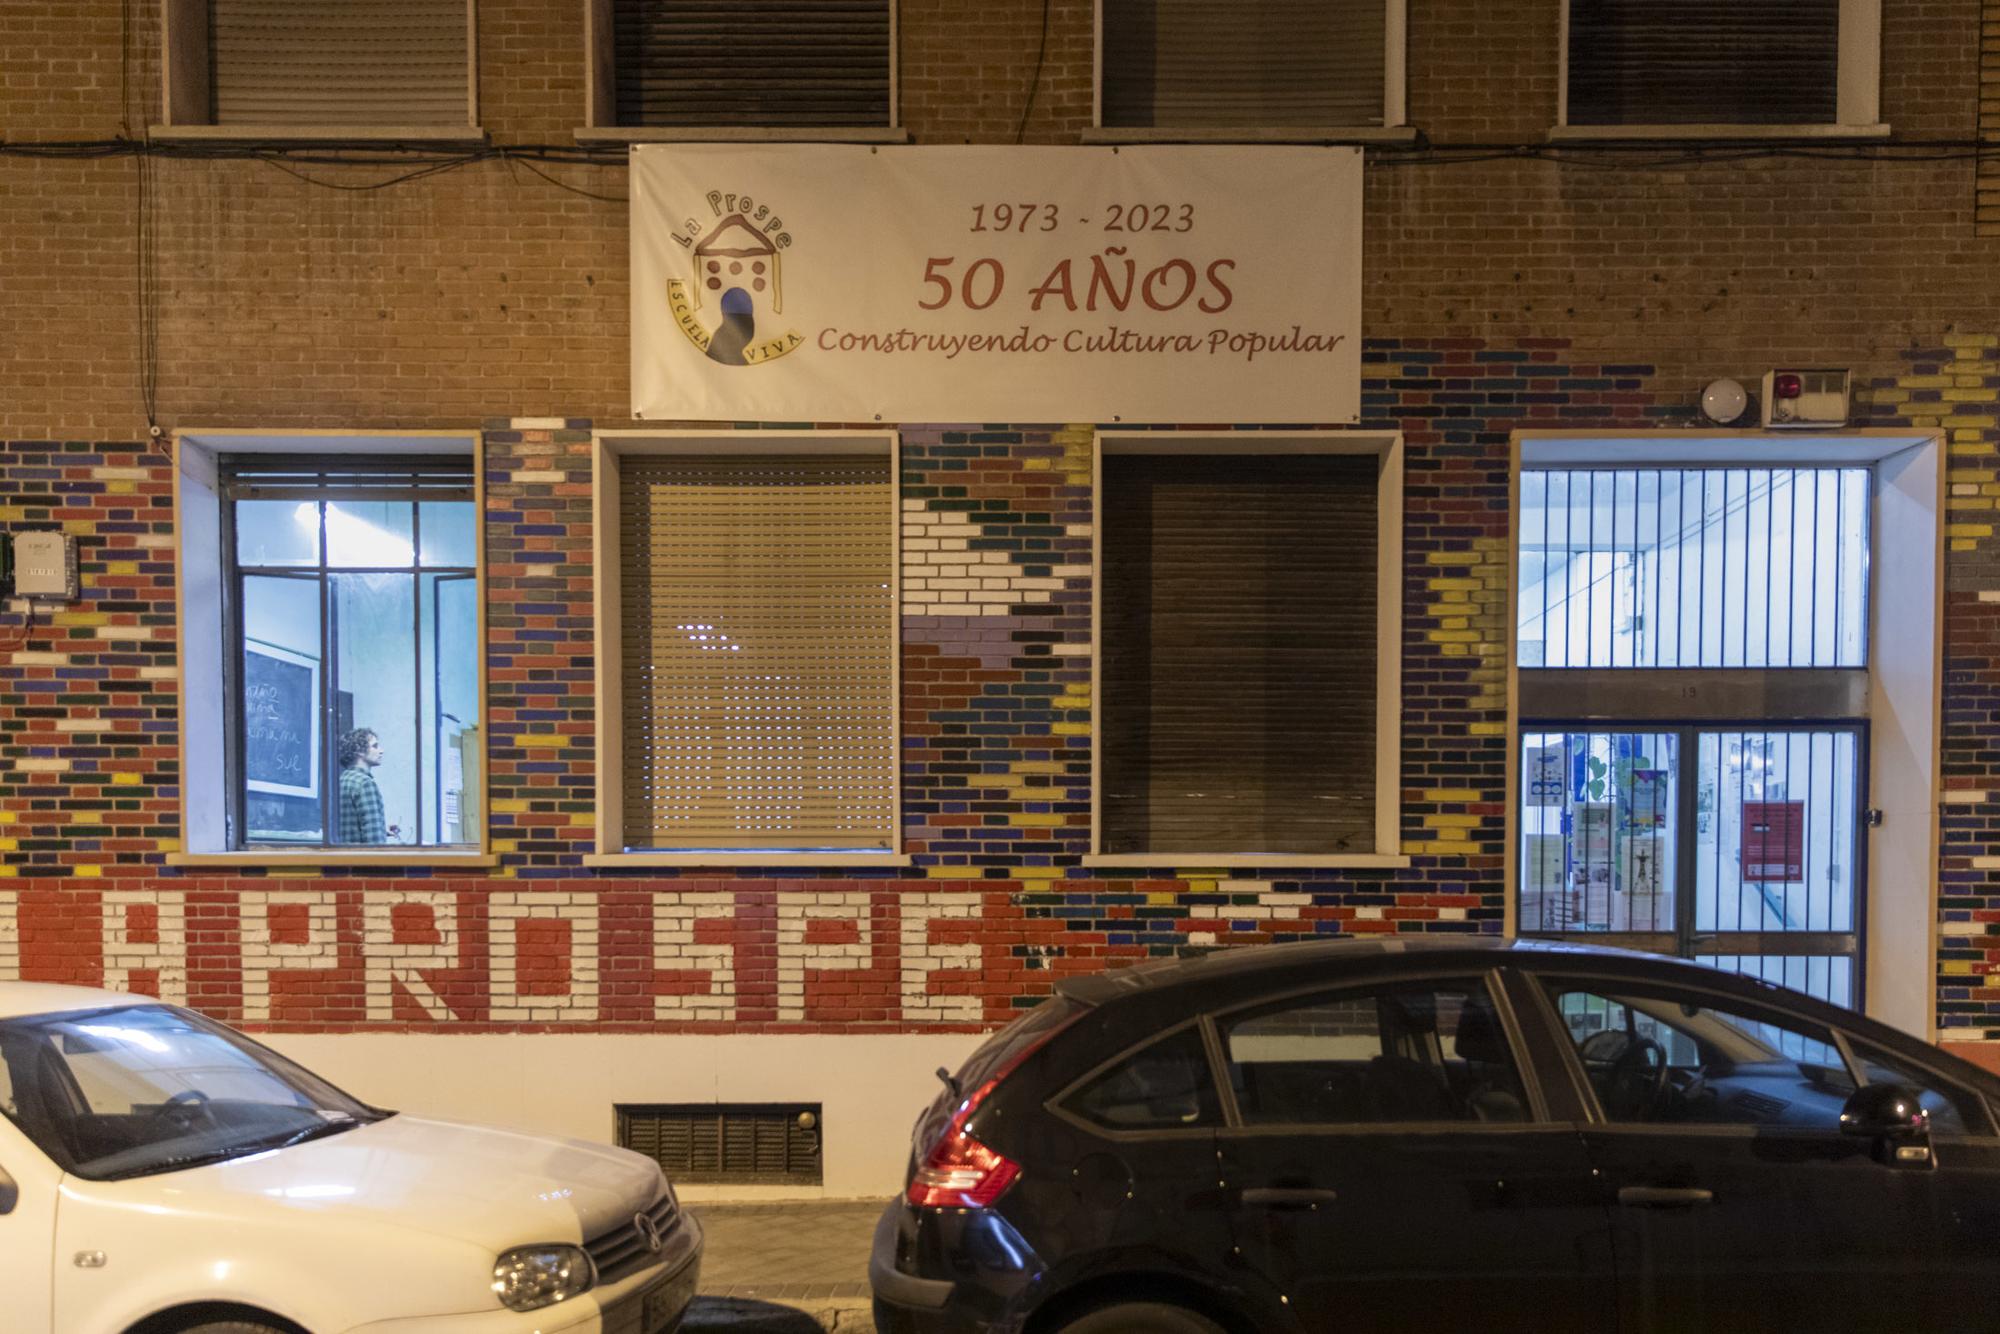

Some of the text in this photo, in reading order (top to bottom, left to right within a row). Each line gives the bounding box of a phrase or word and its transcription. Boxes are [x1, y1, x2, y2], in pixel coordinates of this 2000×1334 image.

[670, 190, 792, 249] La Prospe
[969, 203, 1060, 233] 1973
[1103, 203, 1195, 233] 2023
[918, 246, 1236, 314] 50 AÑOS
[670, 281, 800, 361] ESCUELA VIVA
[818, 325, 1346, 362] Construyendo Cultura Popular
[239, 890, 983, 1021] PROSPE
